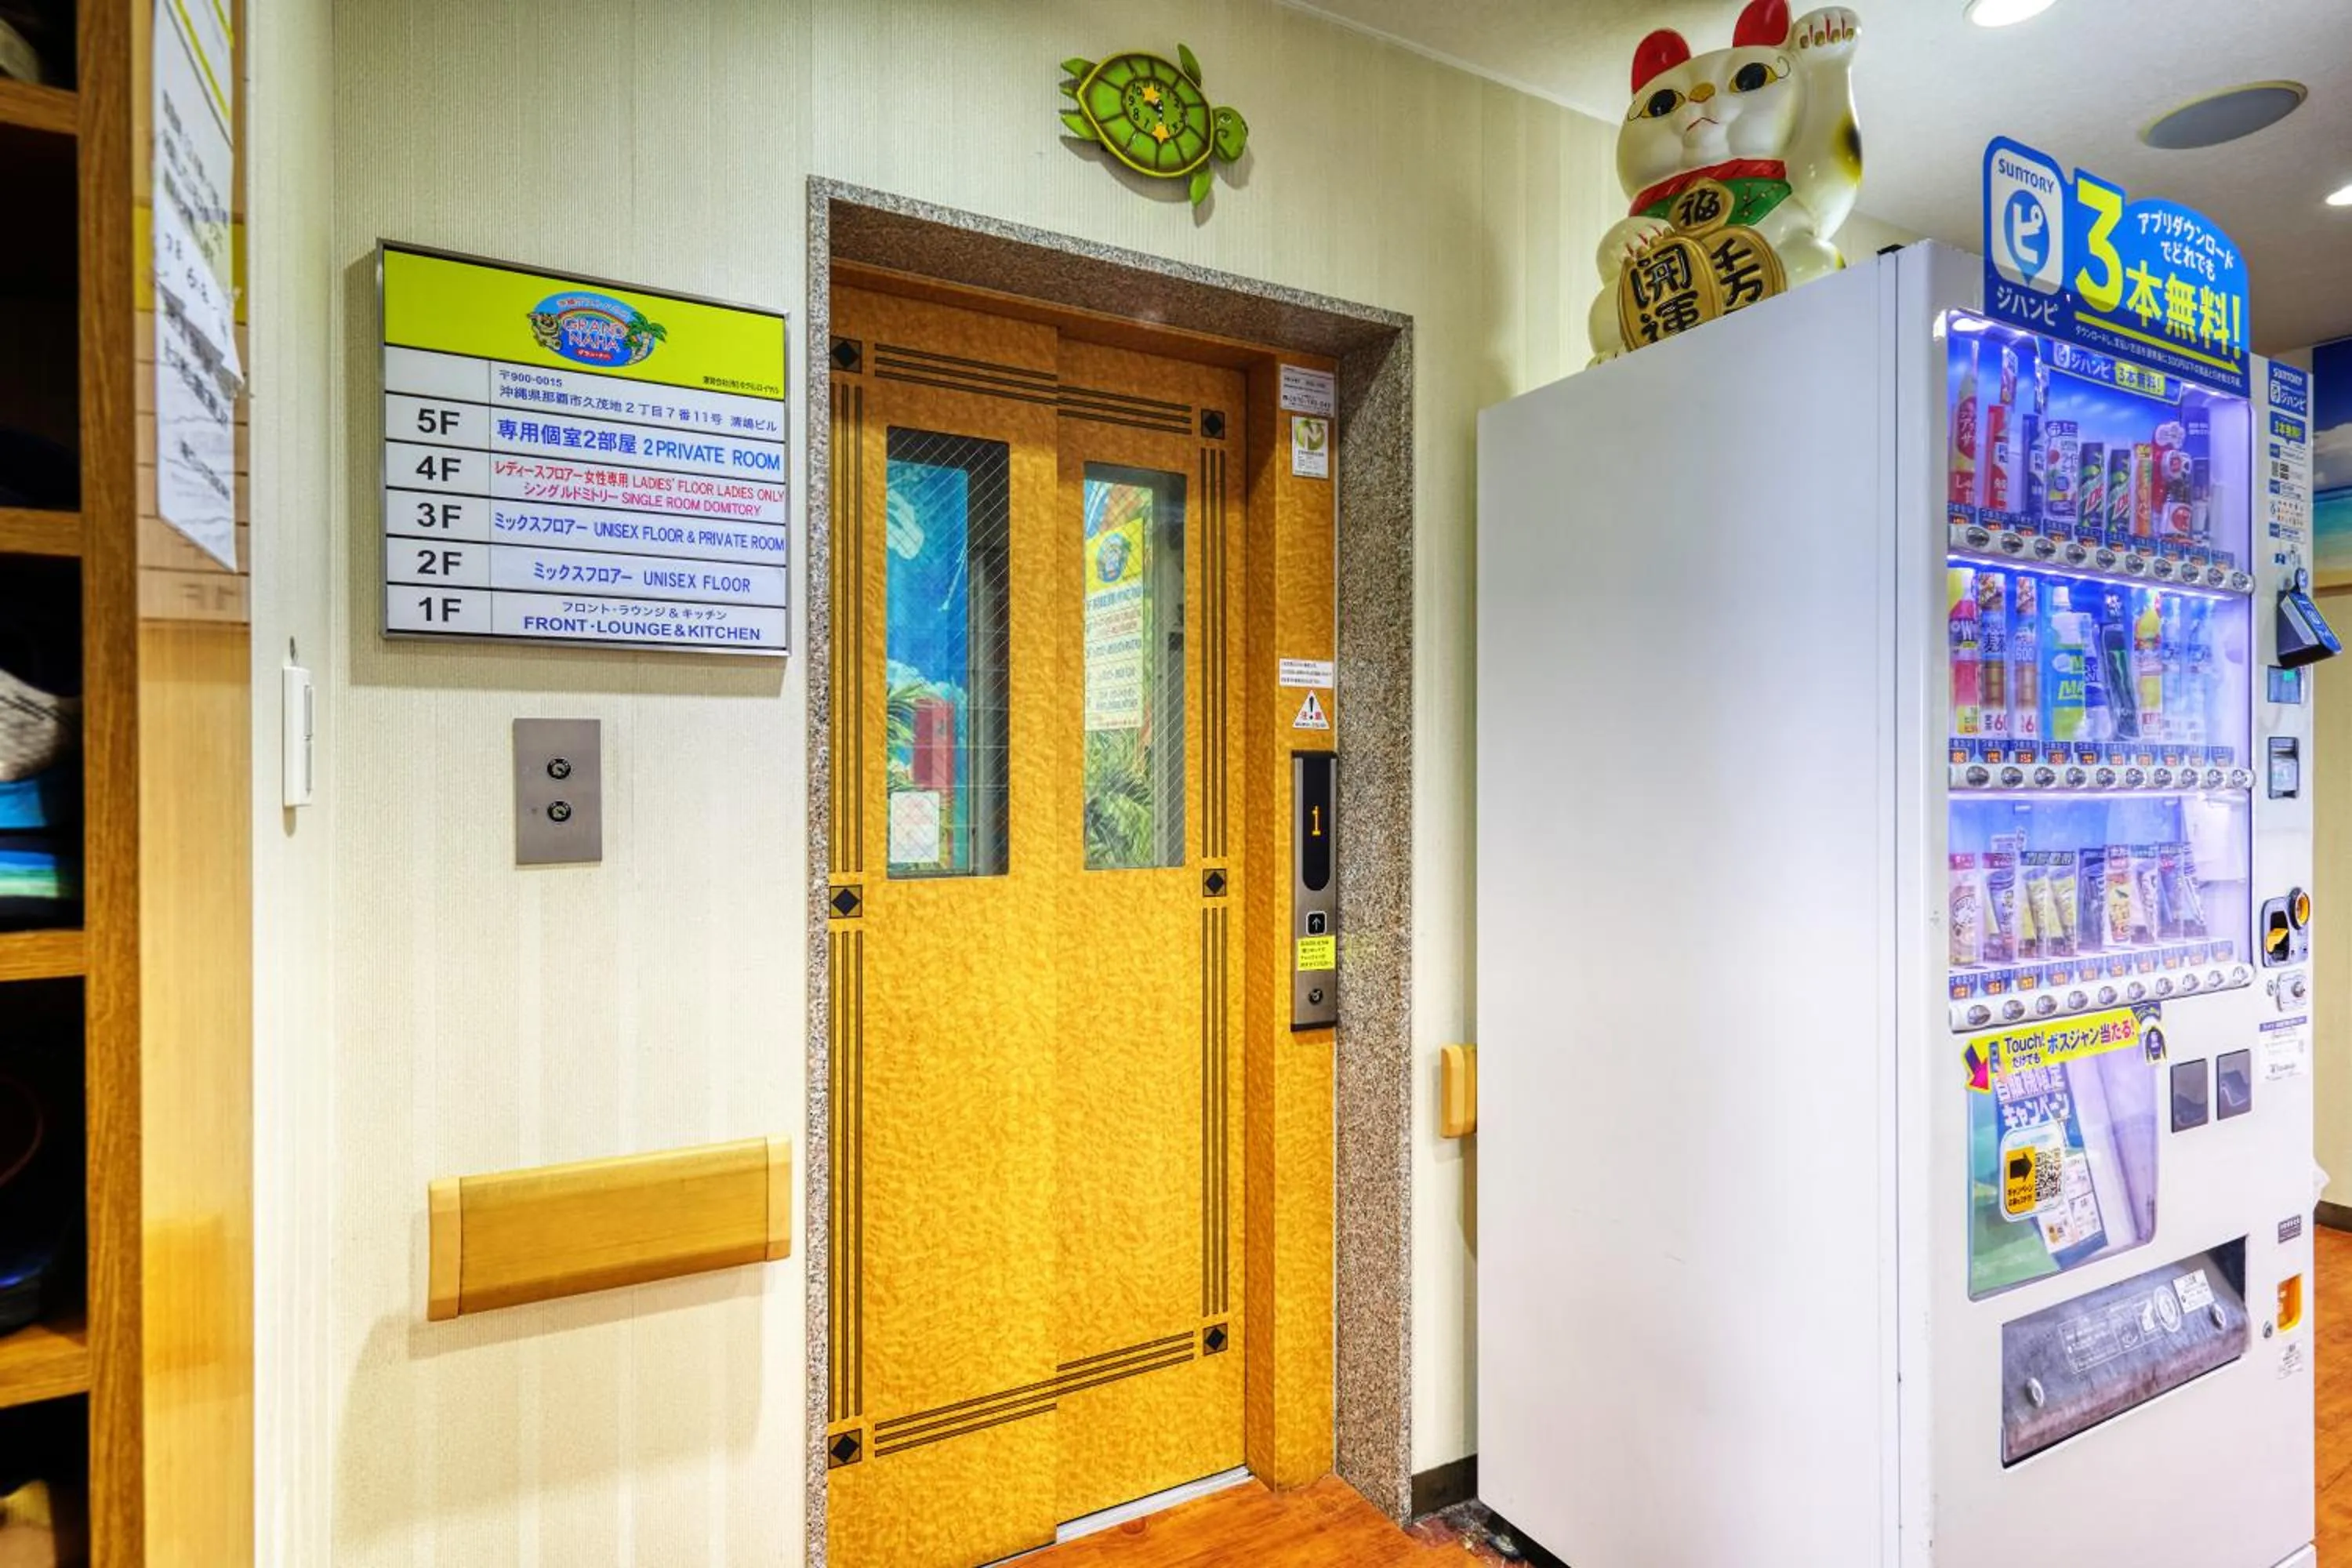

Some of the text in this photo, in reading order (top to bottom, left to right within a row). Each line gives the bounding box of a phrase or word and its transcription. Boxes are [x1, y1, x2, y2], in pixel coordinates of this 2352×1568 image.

[1998, 158, 2055, 194] SUNTORY
[1679, 188, 1722, 226] 福
[2136, 209, 2234, 270] アプリダウンロード
[2161, 241, 2216, 282] でどれでも
[1711, 238, 1766, 315] 千万
[1996, 285, 2059, 326] ジハンピ
[561, 316, 627, 339] GRAND
[568, 329, 620, 353] NAHA
[417, 408, 460, 434] 5F
[497, 419, 637, 455] 専用個室2部屋
[732, 448, 781, 471] ROOM
[416, 456, 462, 481] 4F
[524, 481, 762, 516] シングルドミトリー SINGLE ROOM DOMITORY
[677, 480, 714, 496] FLOOR
[717, 485, 753, 500] LADIES
[757, 488, 784, 503] ONLY
[417, 503, 462, 529] 3F
[495, 512, 784, 551] ミックスフロアー UNISEX FLOOR & PRIVATE ROOM
[417, 550, 463, 576] 2F
[534, 561, 751, 593] ミックスフロアー UNISEX FLOOR
[418, 597, 463, 622] 1F
[669, 608, 679, 619] &
[1312, 804, 1321, 836] 1
[2004, 1031, 2045, 1055] Touch!
[2012, 1052, 2041, 1068] だけでも
